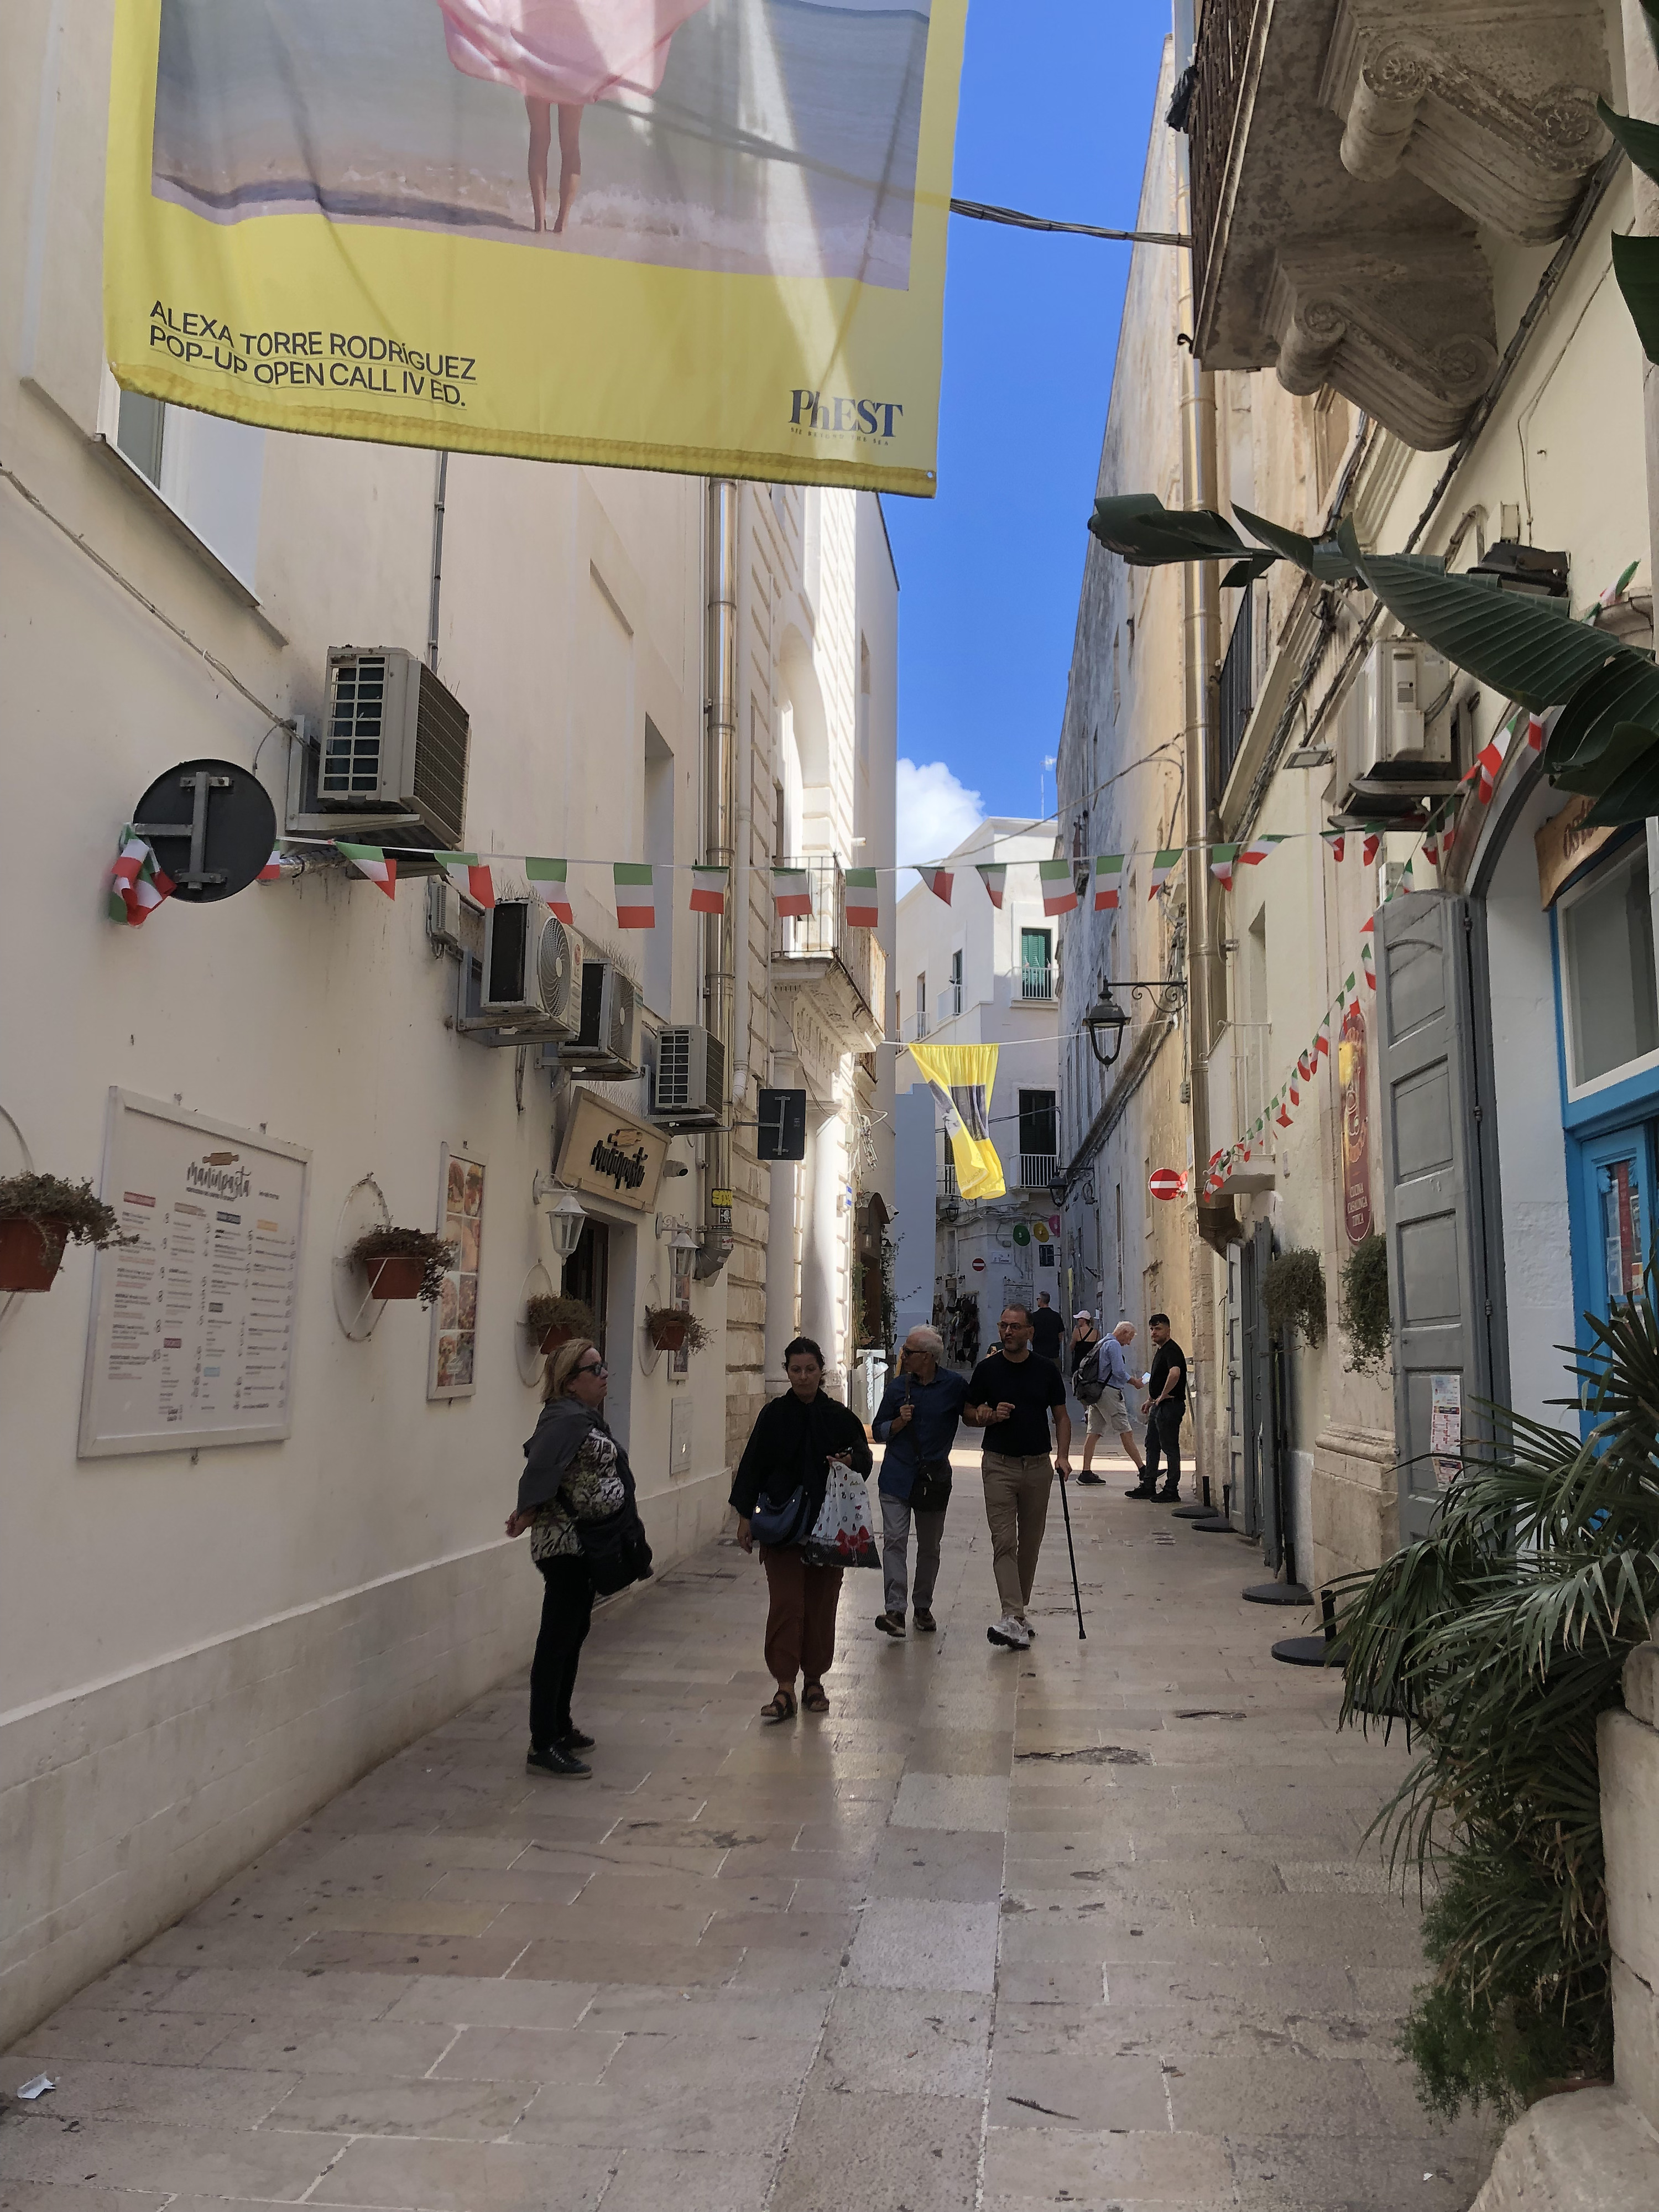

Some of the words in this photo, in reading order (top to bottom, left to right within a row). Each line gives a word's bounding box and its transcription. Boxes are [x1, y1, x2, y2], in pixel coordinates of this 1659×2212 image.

[150, 300, 234, 348] ALEXA
[239, 331, 323, 357] TORRE
[150, 325, 248, 374] POP-UP
[254, 361, 324, 386] OPEN
[330, 362, 397, 393] CALL
[403, 371, 425, 395] IV
[430, 378, 466, 407] ED.
[788, 389, 904, 437] PhEST
[1350, 1182, 1364, 1198] CUCINA
